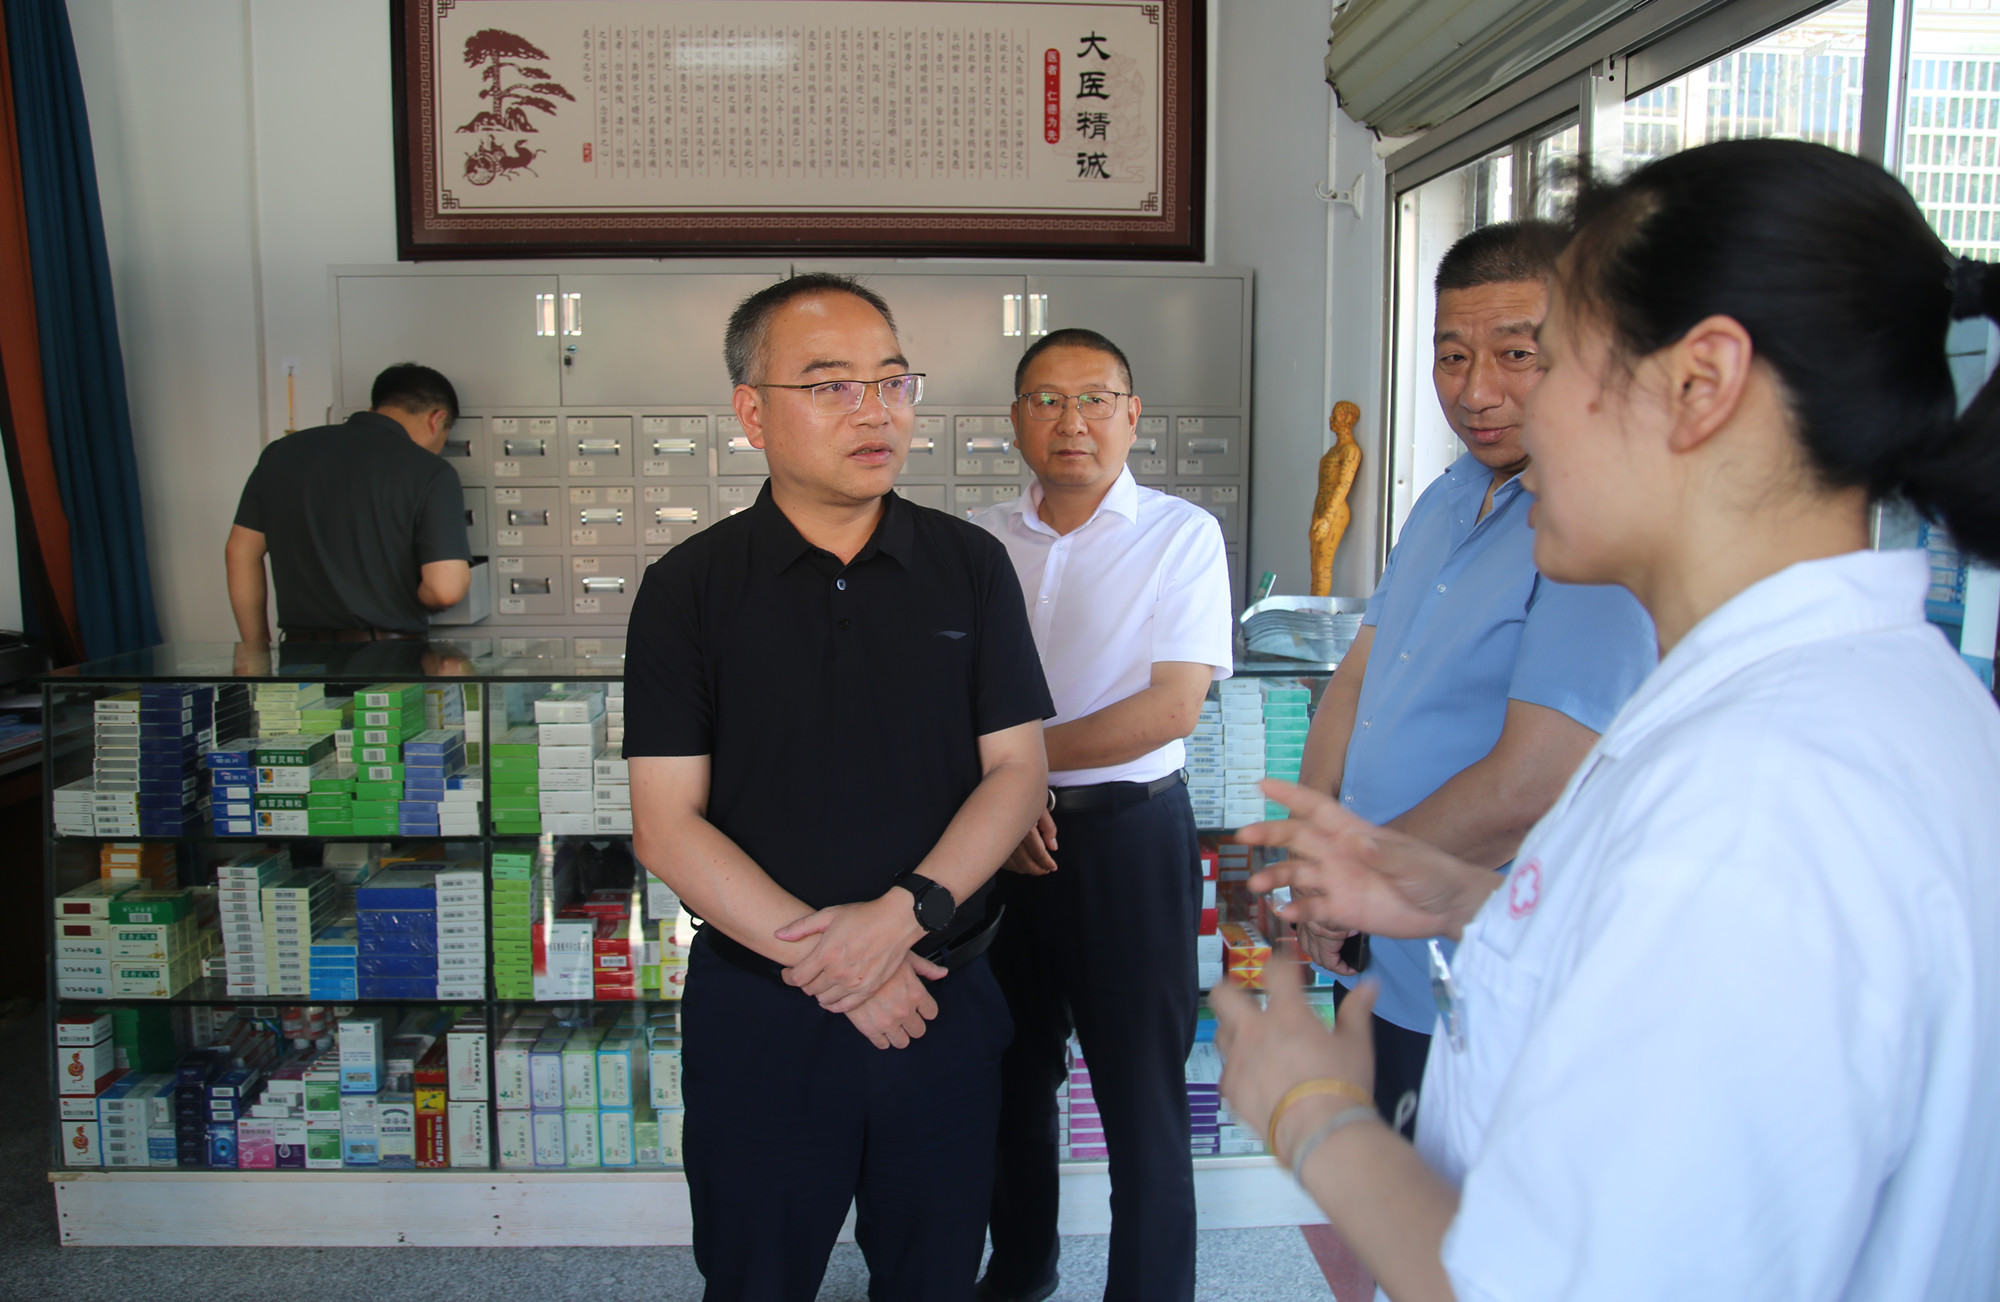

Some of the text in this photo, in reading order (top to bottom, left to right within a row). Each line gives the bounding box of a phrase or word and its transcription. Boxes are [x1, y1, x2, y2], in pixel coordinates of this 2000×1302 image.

[1076, 30, 1111, 179] 大医精诚
[260, 755, 303, 764] 感冒灵颗粒
[259, 799, 302, 808] 感冒灵颗粒
